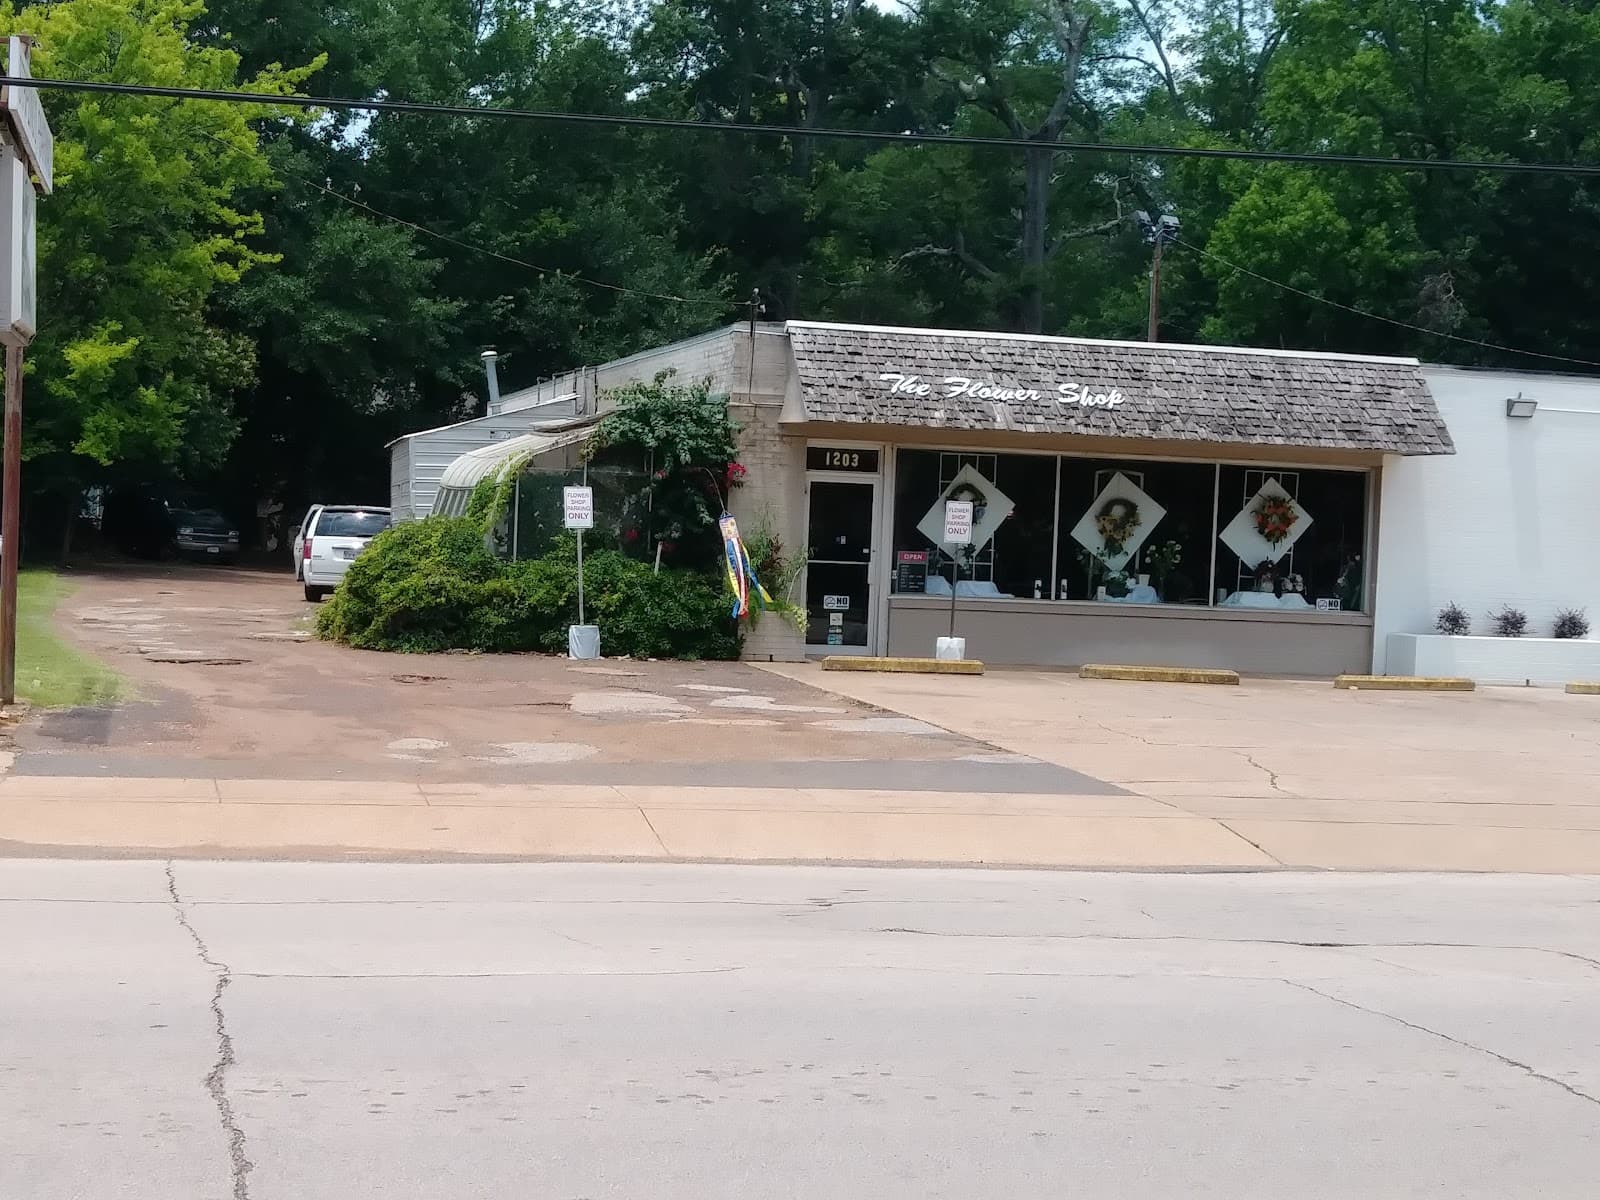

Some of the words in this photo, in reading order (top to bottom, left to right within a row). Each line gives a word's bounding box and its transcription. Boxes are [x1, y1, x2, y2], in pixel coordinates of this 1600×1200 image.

[879, 373, 932, 397] The
[943, 377, 1042, 401] Flower
[1057, 383, 1126, 409] Shop
[825, 451, 859, 467] 1203
